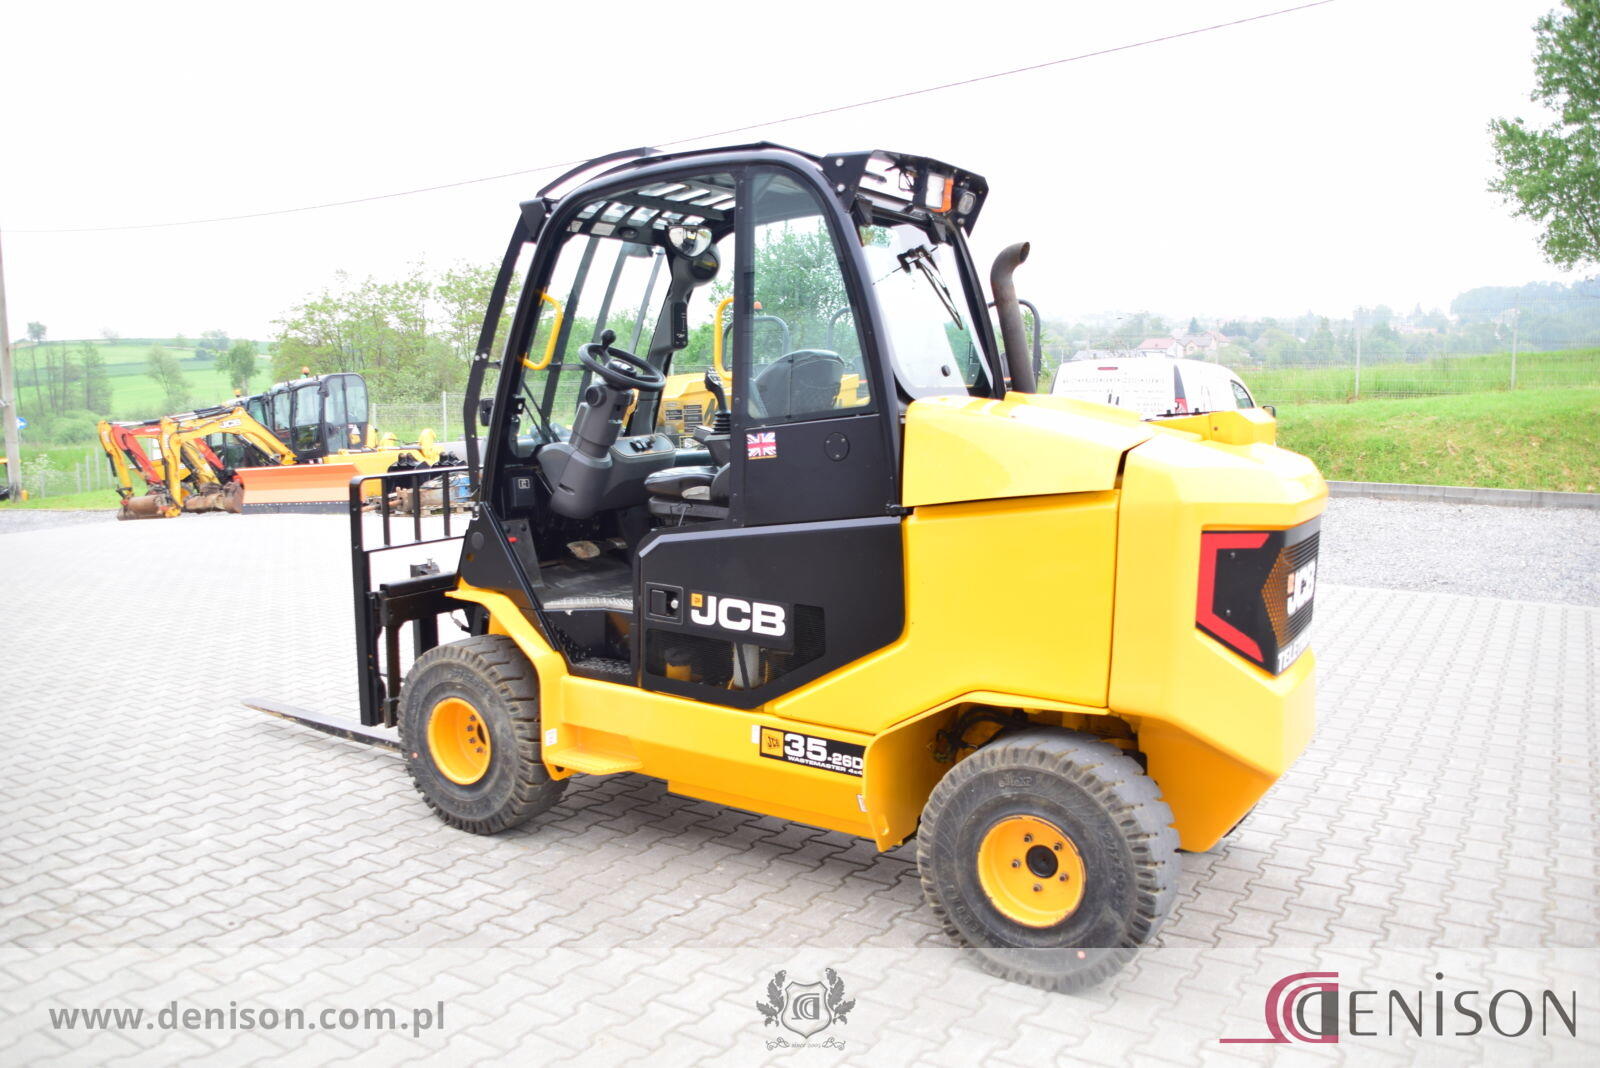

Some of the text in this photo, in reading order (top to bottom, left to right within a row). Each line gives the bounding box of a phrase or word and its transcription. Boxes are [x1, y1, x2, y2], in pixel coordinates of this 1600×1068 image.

[1287, 561, 1316, 615] JCB
[690, 595, 786, 636] JCB
[787, 755, 846, 772] WASTEMASTER
